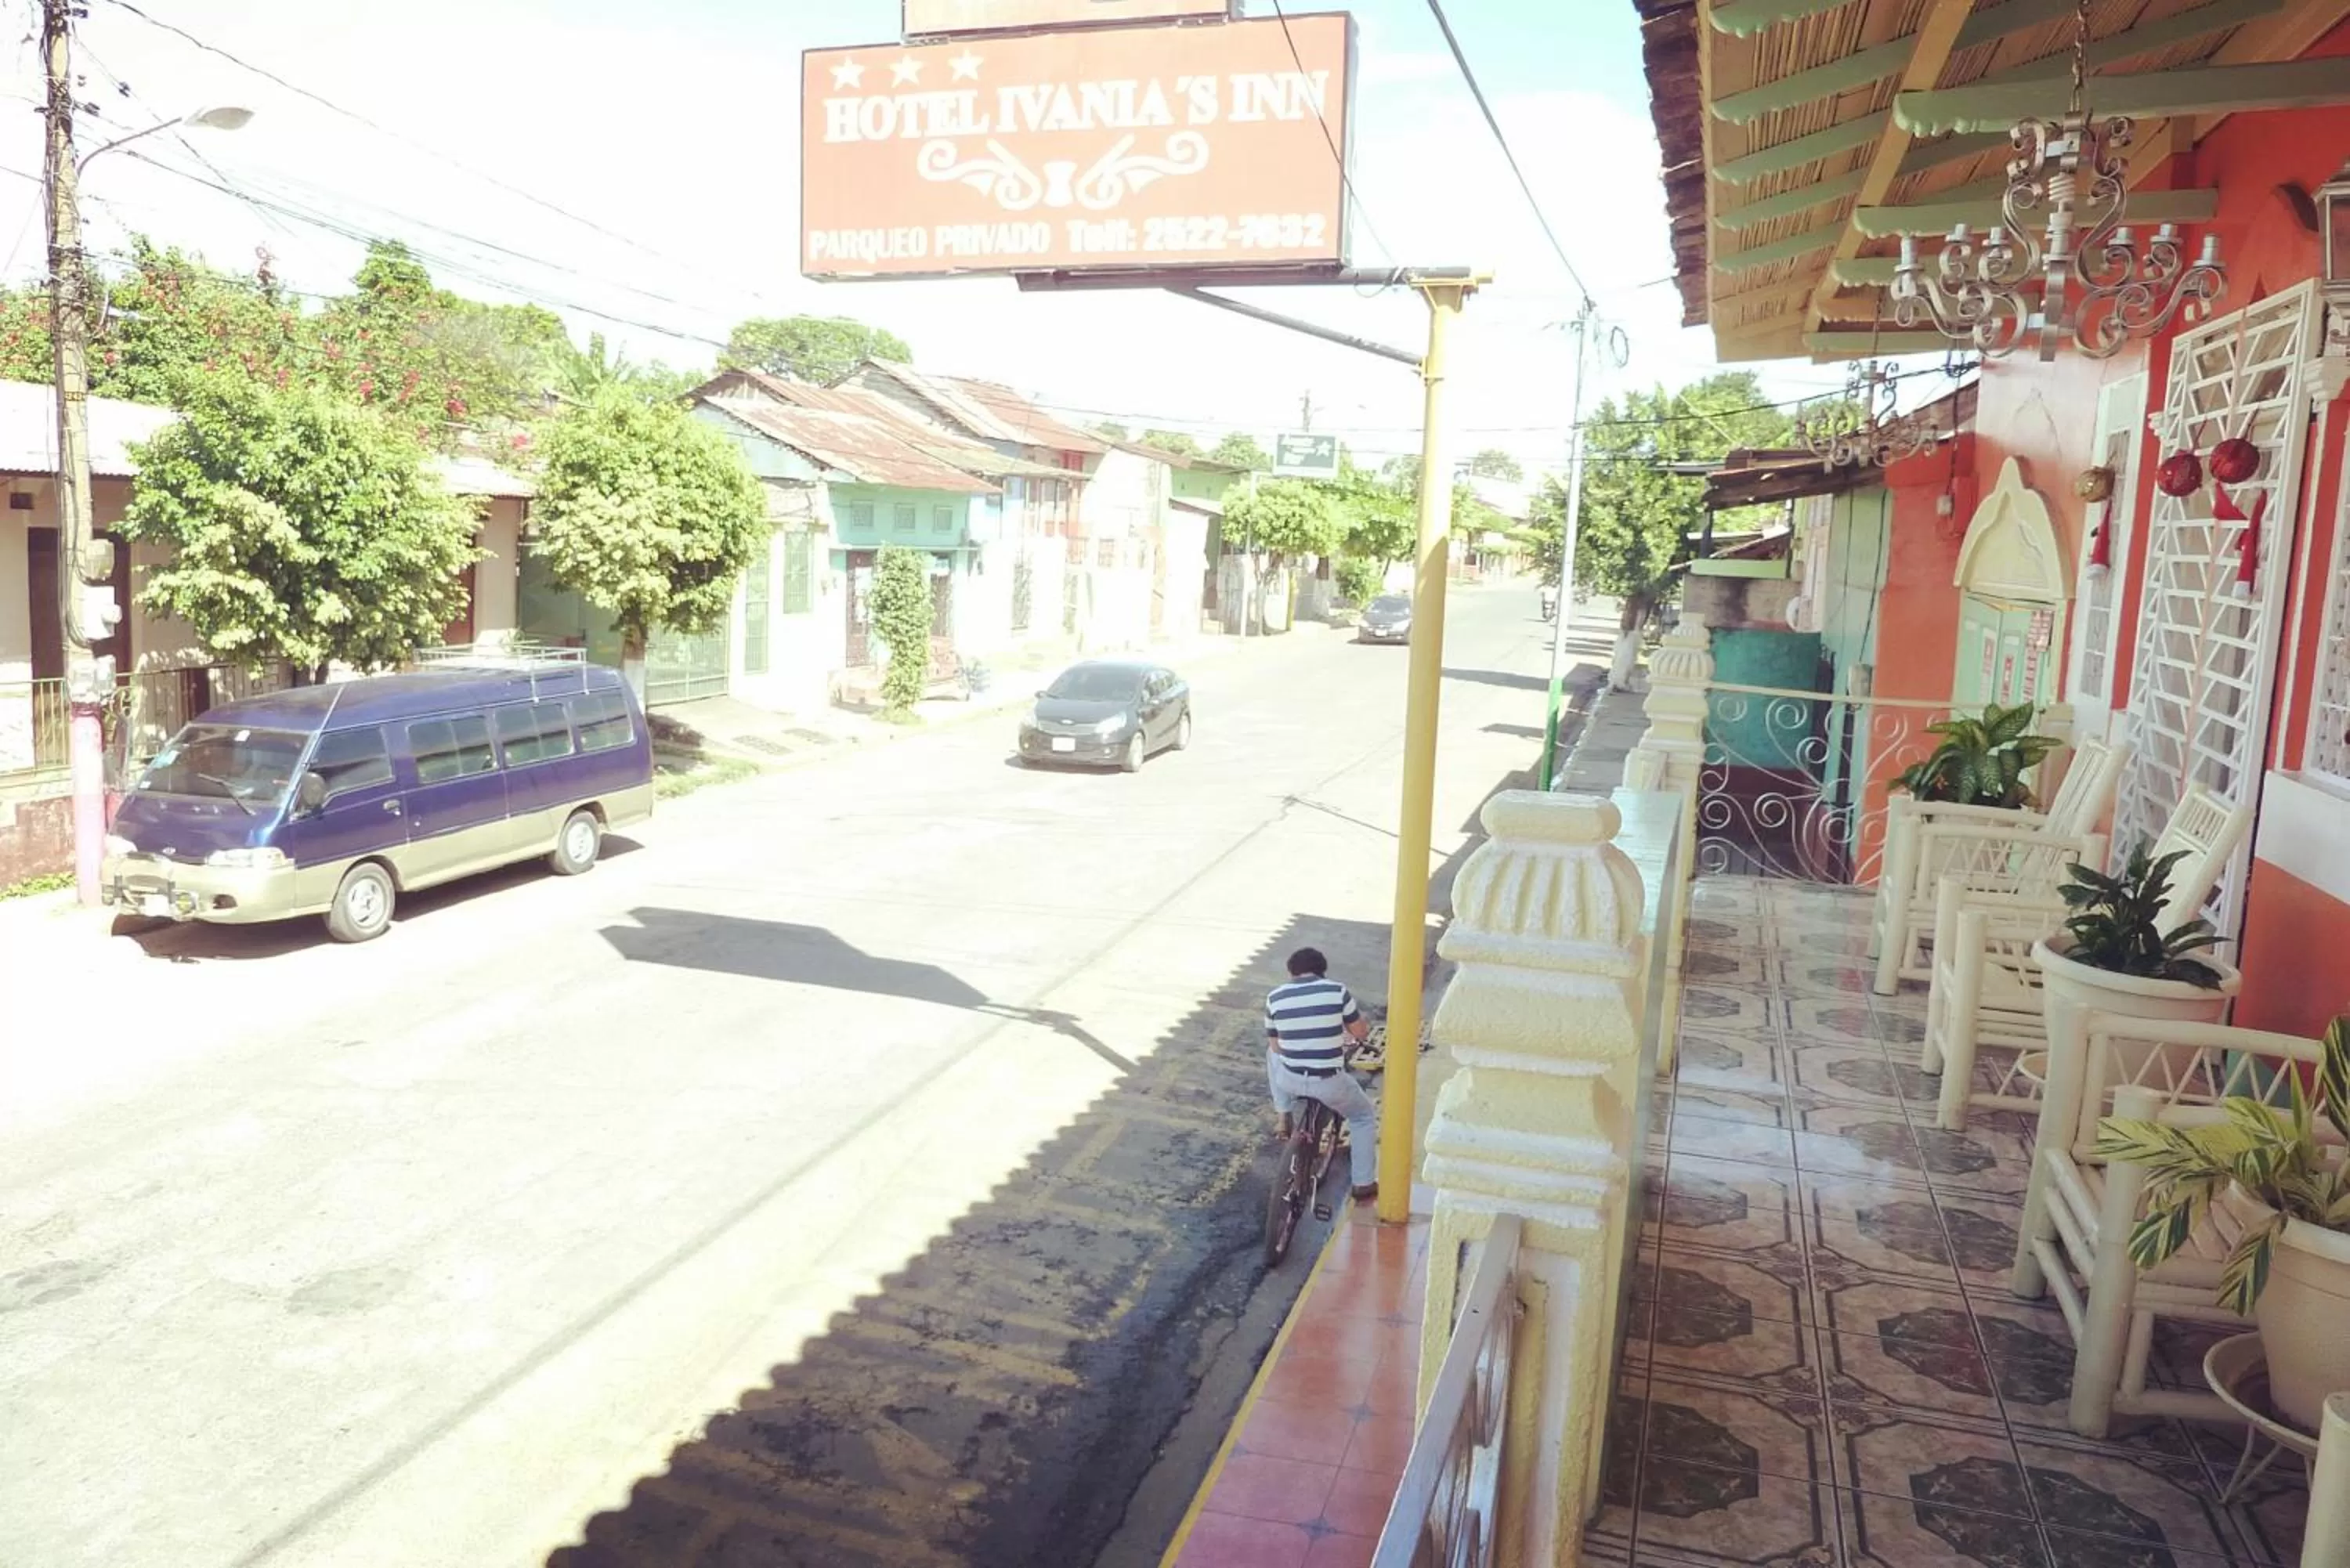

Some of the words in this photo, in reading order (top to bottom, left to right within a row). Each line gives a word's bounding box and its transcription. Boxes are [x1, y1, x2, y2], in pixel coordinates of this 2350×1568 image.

[823, 89, 991, 143] HOTEL
[996, 75, 1220, 134] IVANIA'S
[1228, 70, 1329, 122] INN
[808, 226, 929, 263] PARQUEO
[935, 221, 1051, 258] PRIVADO
